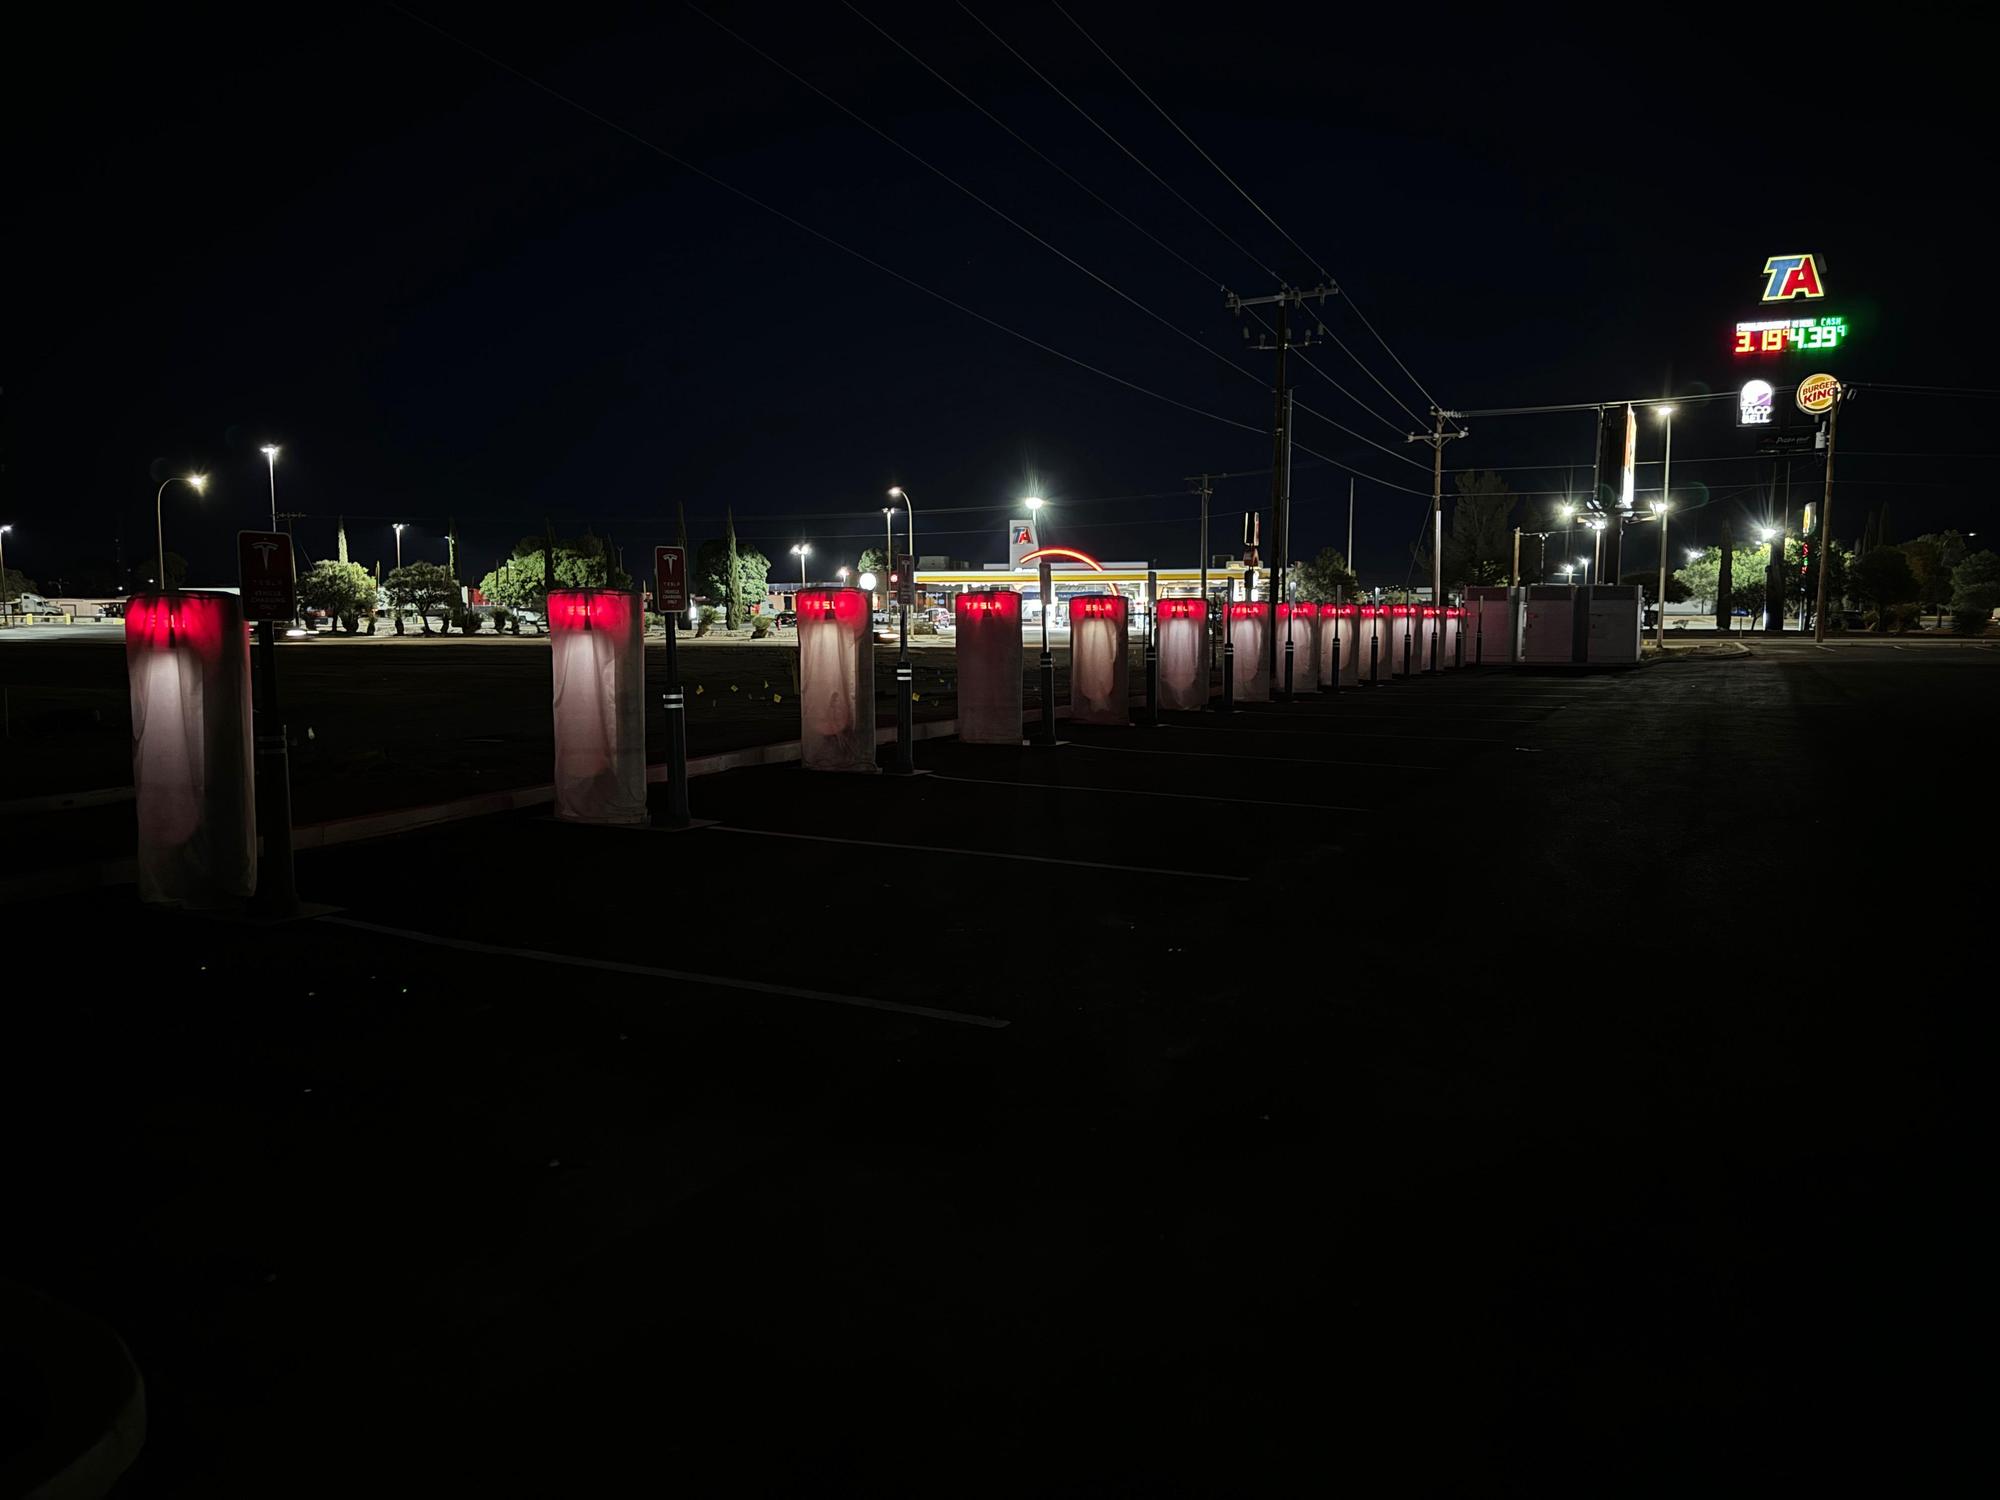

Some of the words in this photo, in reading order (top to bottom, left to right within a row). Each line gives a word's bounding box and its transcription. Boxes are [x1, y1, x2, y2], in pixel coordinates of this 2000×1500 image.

[1762, 254, 1824, 301] TA
[1821, 317, 1842, 326] CASH
[1741, 405, 1771, 414] TACO
[1742, 414, 1772, 424] BELL
[1012, 526, 1034, 544] TA
[965, 601, 1002, 610] TESLA
[1084, 604, 1112, 612] ESLA
